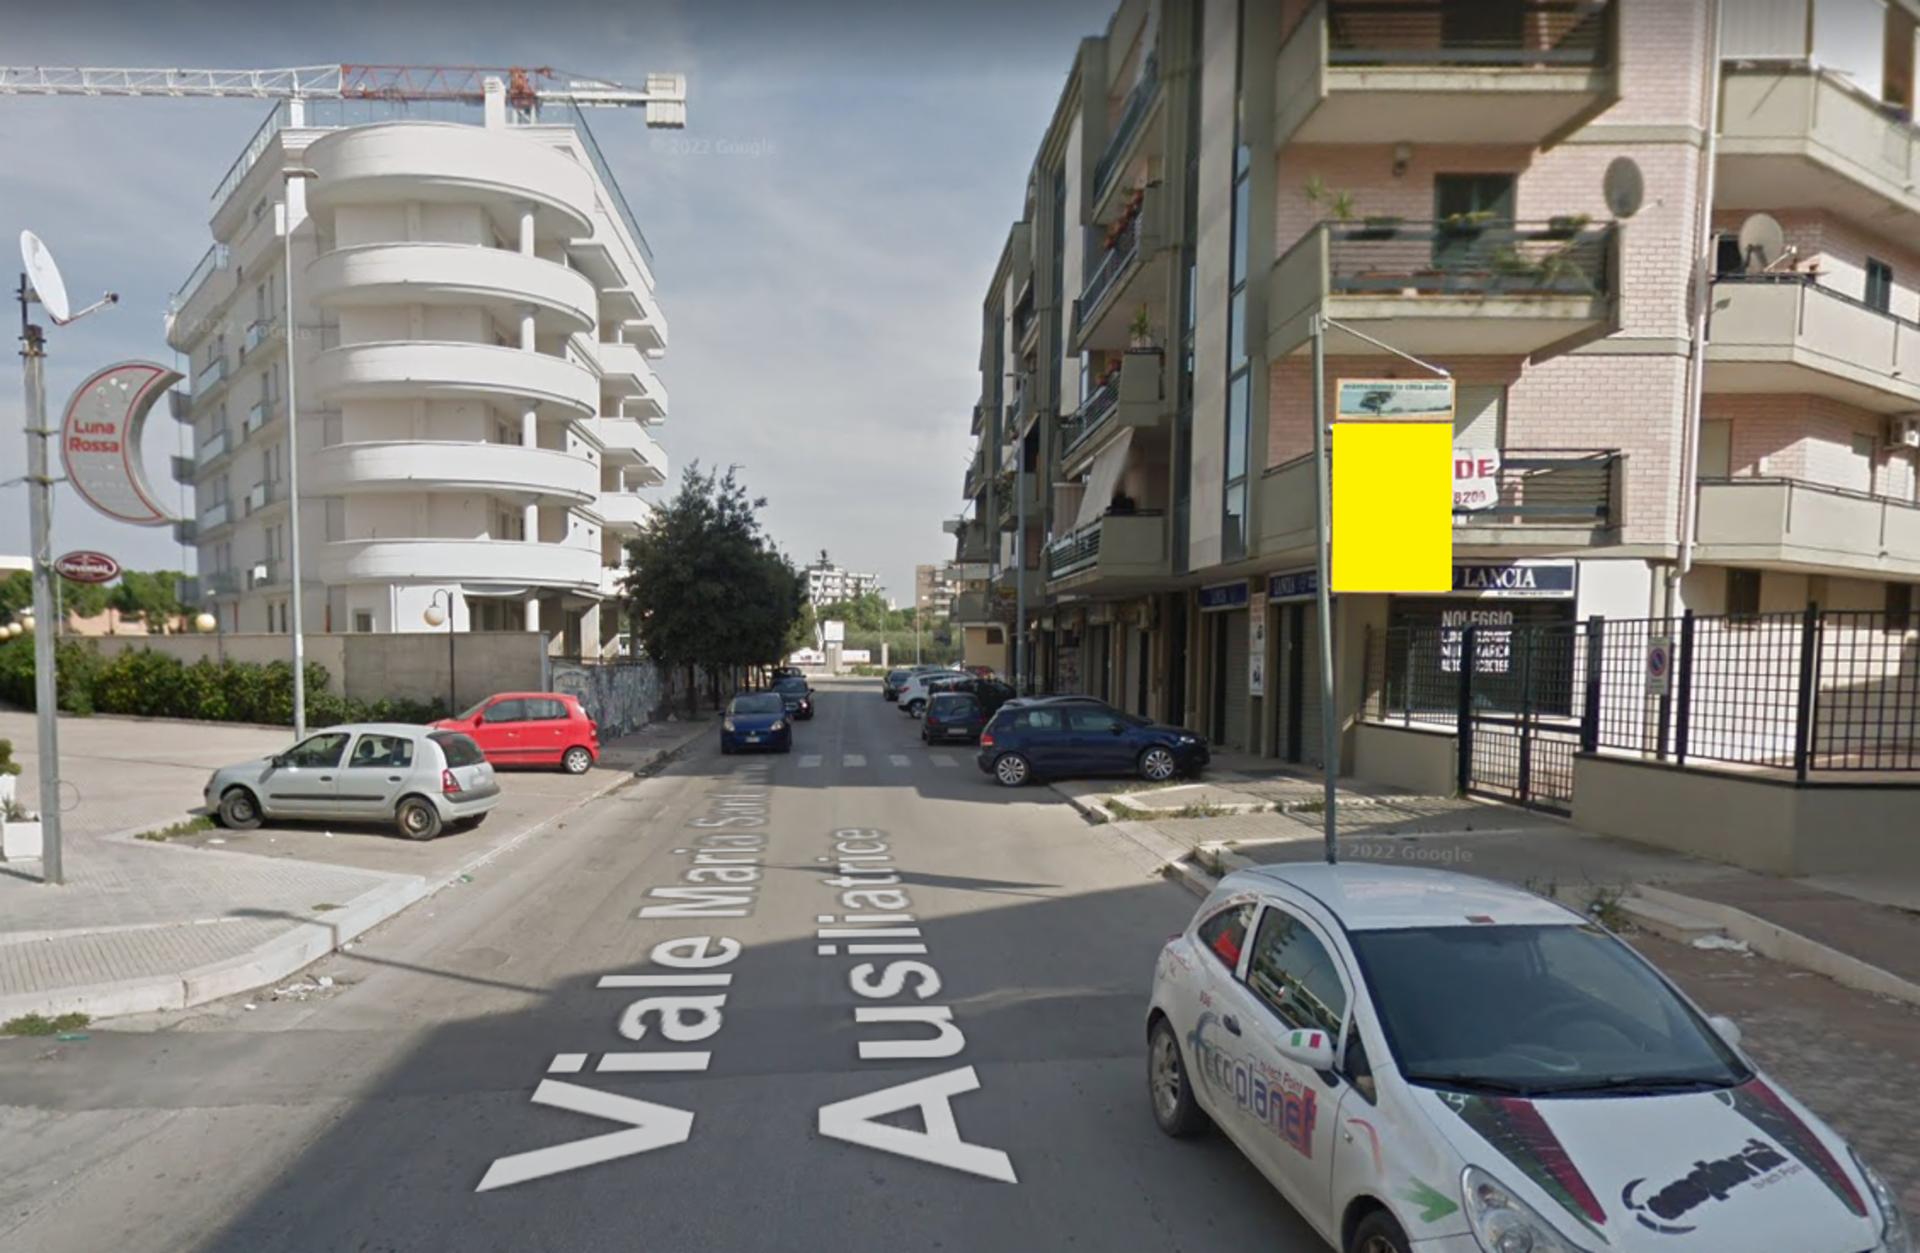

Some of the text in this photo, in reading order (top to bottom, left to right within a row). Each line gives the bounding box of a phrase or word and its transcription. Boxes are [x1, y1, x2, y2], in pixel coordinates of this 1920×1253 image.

[74, 419, 115, 434] Luna
[69, 437, 119, 452] Rossa
[1464, 568, 1536, 588] LANCIA
